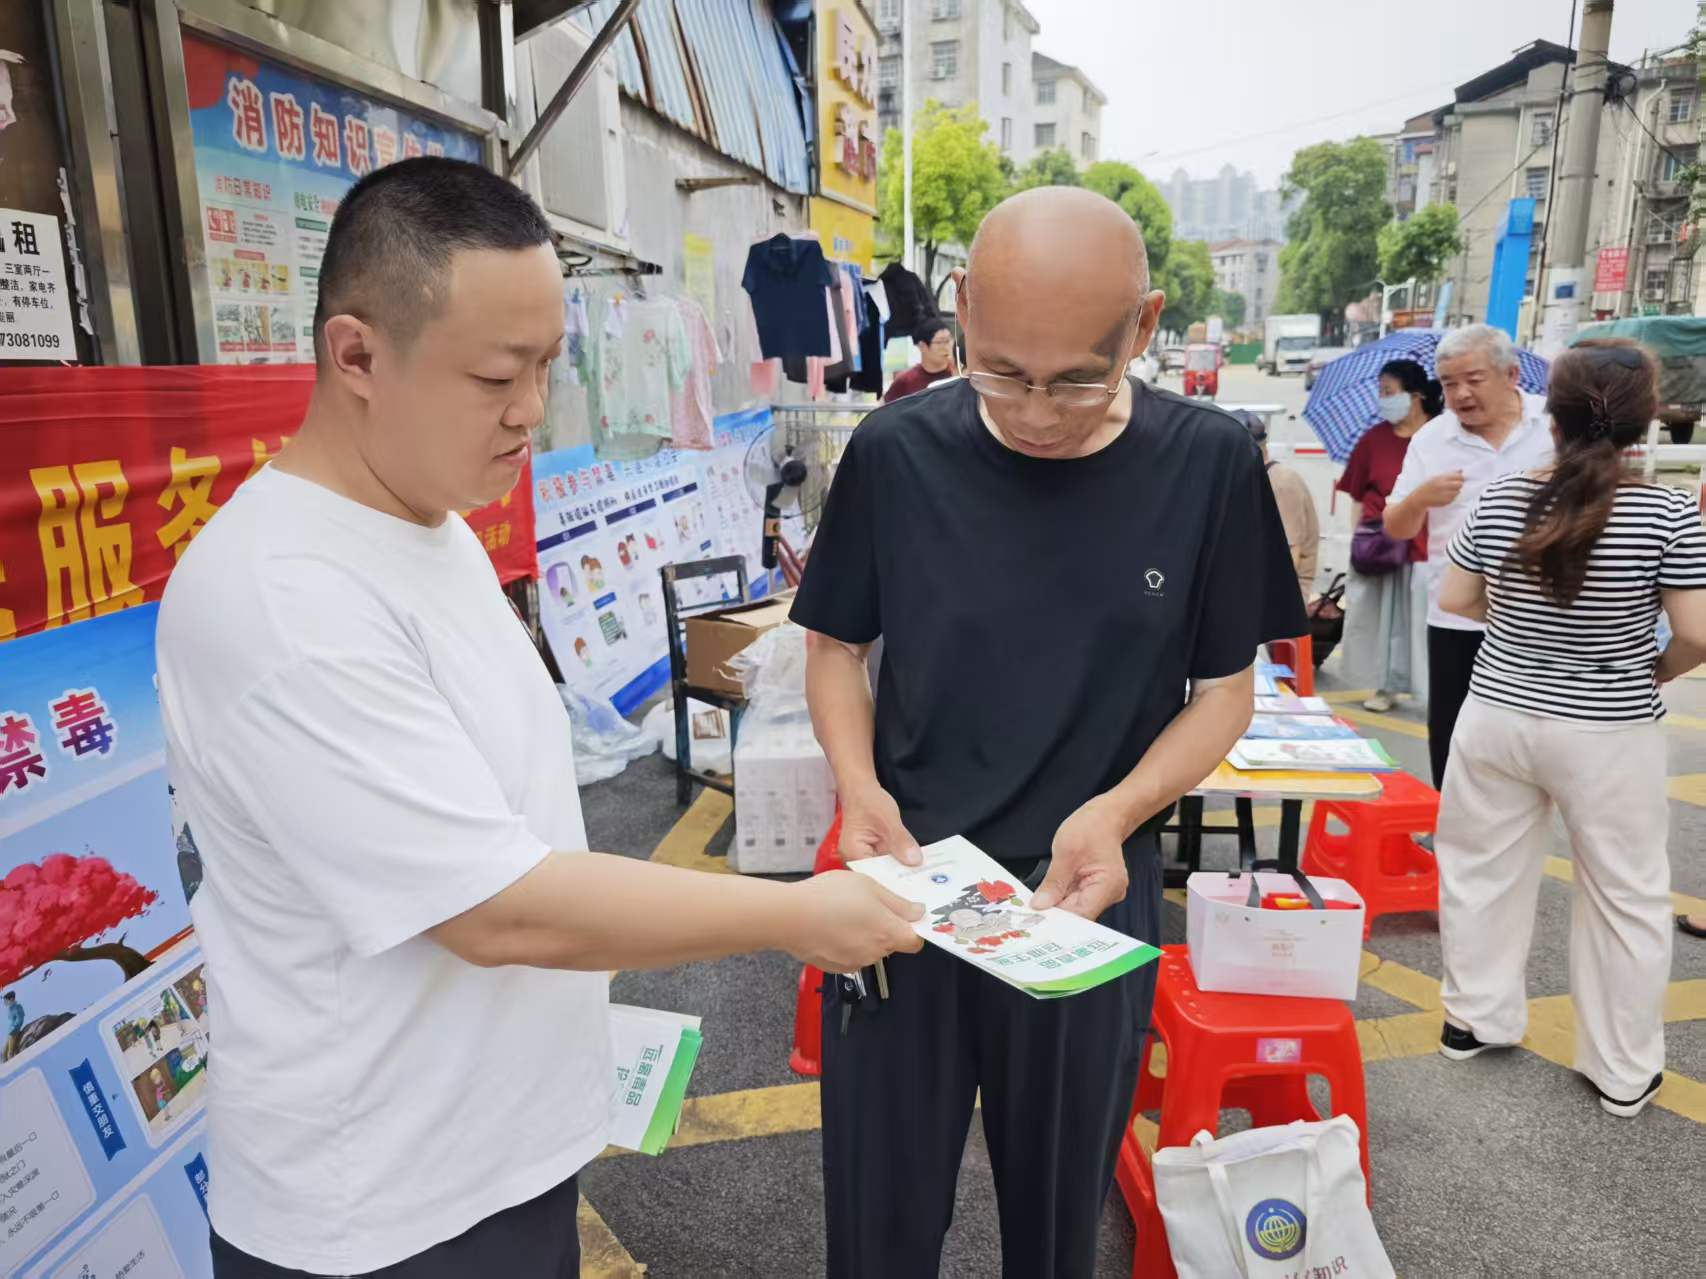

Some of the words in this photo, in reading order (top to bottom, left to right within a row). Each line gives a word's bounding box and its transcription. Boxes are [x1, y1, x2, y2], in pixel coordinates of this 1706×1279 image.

[0, 221, 40, 255] 租
[477, 519, 512, 552] 活动
[0, 691, 114, 795] 禁毒
